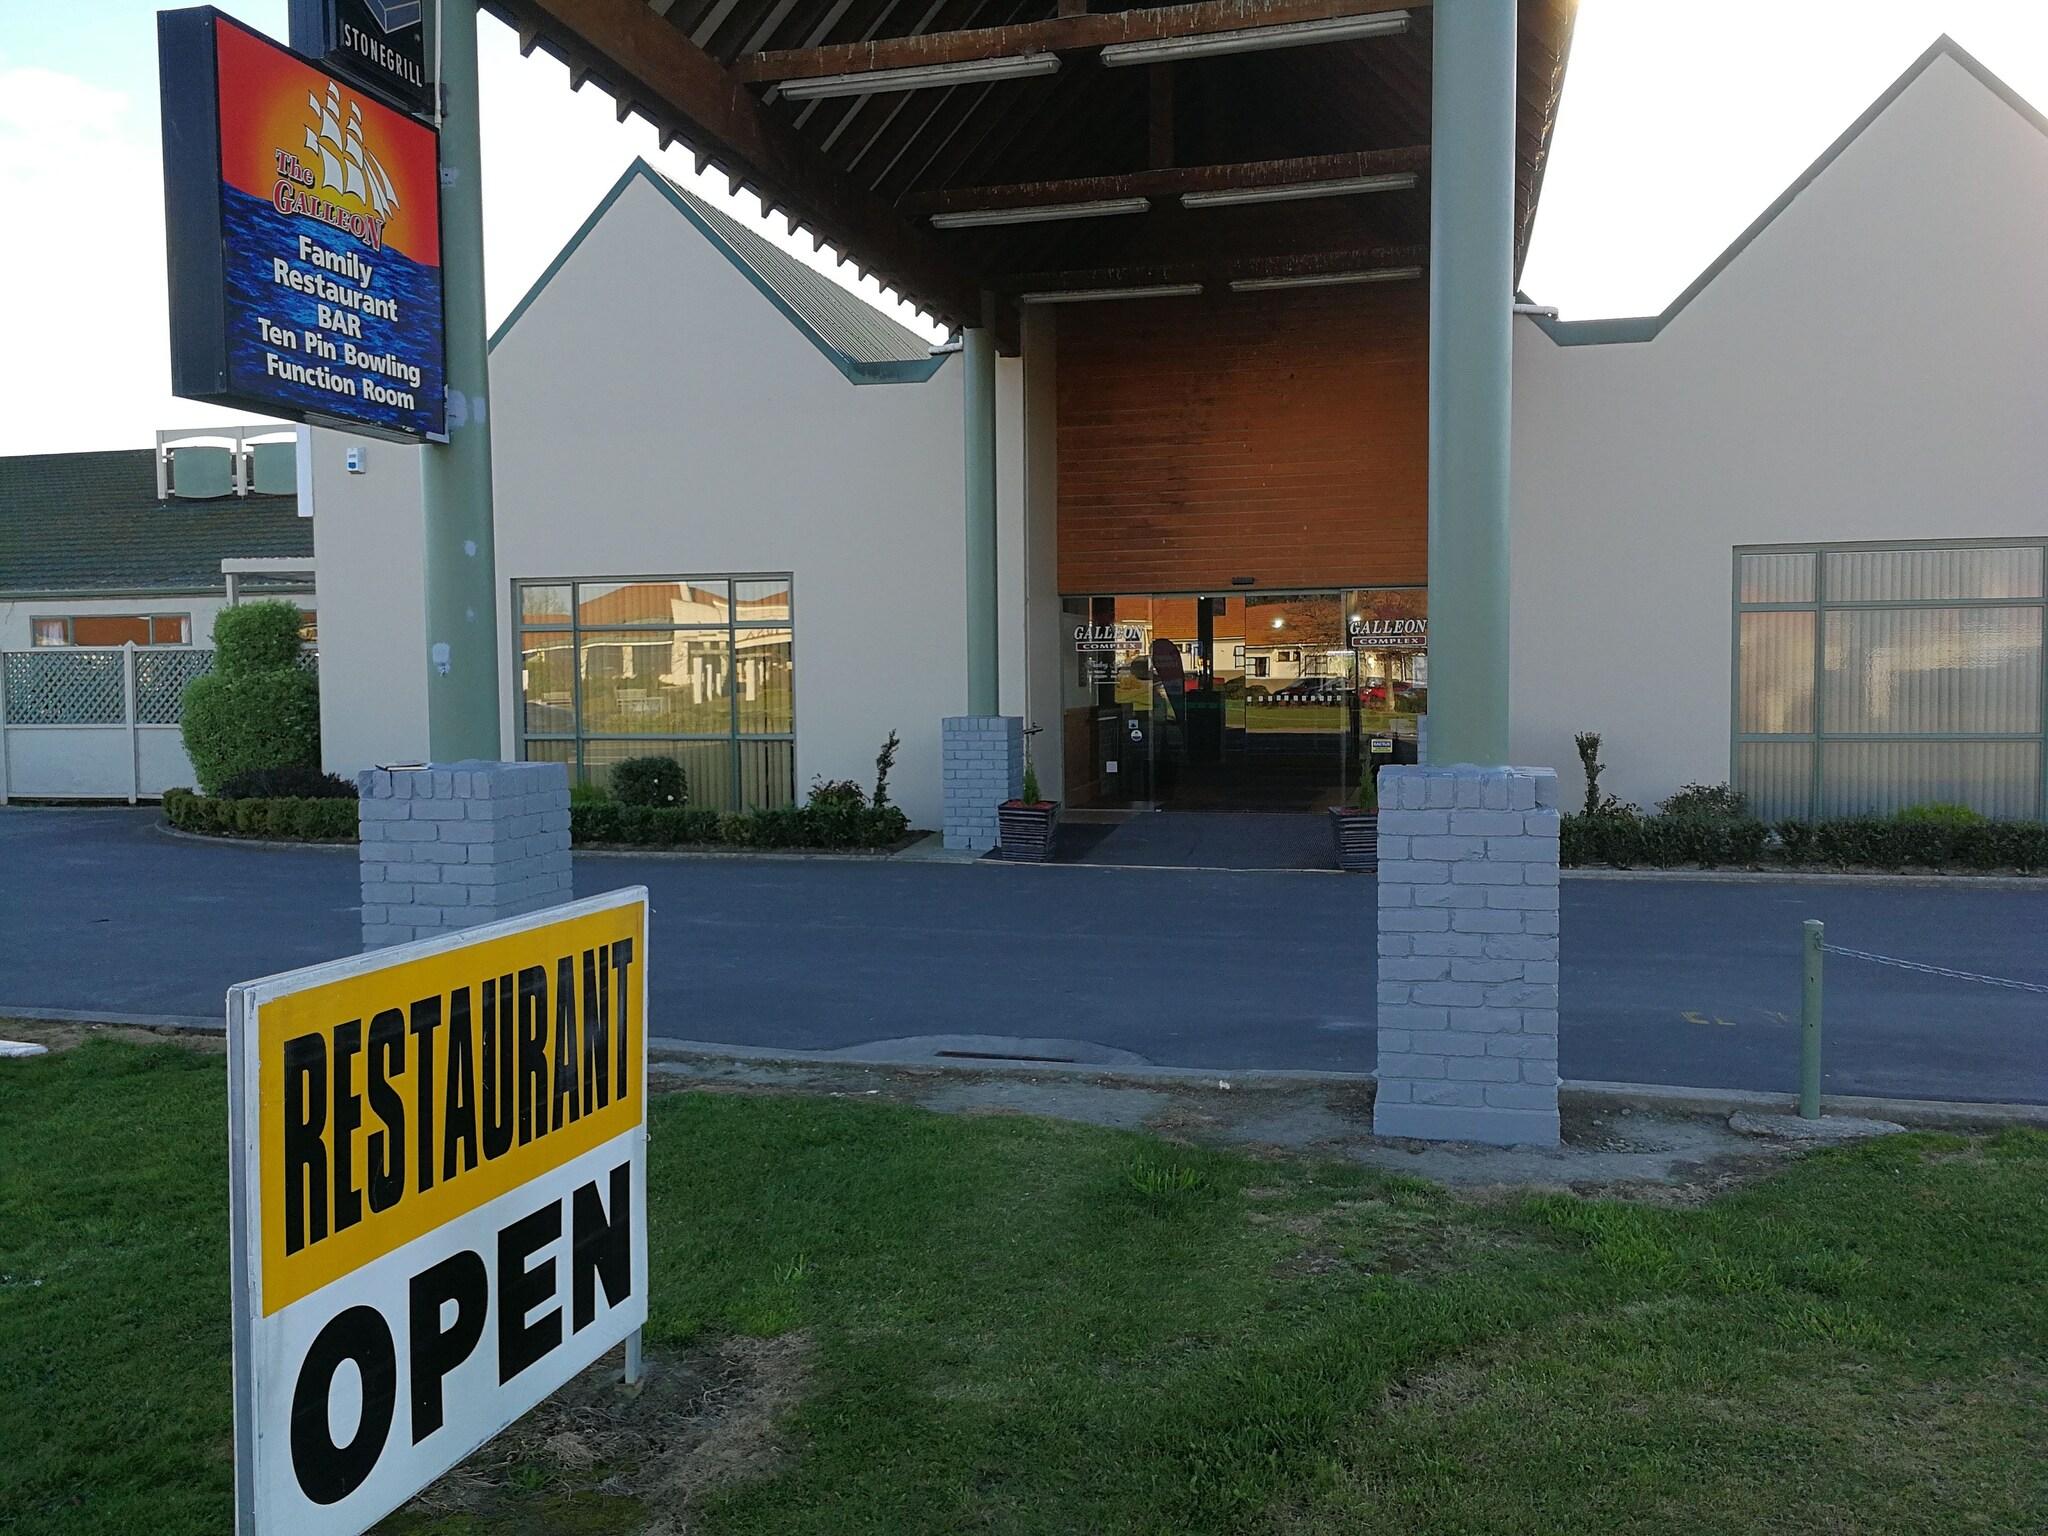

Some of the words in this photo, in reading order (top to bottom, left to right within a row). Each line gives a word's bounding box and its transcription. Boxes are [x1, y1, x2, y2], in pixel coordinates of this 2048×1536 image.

[344, 23, 423, 88] STONEGRILL
[275, 148, 315, 187] The
[272, 179, 385, 252] GALLEON
[273, 257, 398, 322] Restaurant
[299, 235, 373, 288] Family
[317, 304, 362, 339] BAR
[258, 317, 297, 349] Ten
[305, 331, 337, 360] Pin
[344, 342, 421, 388] Bowling
[266, 353, 356, 396] Function
[362, 378, 415, 410] Room
[1073, 625, 1144, 640] GALLEON
[1349, 619, 1428, 635] GALLEON
[284, 937, 633, 1258] RESTAURANT
[290, 1160, 632, 1506] OPEN
